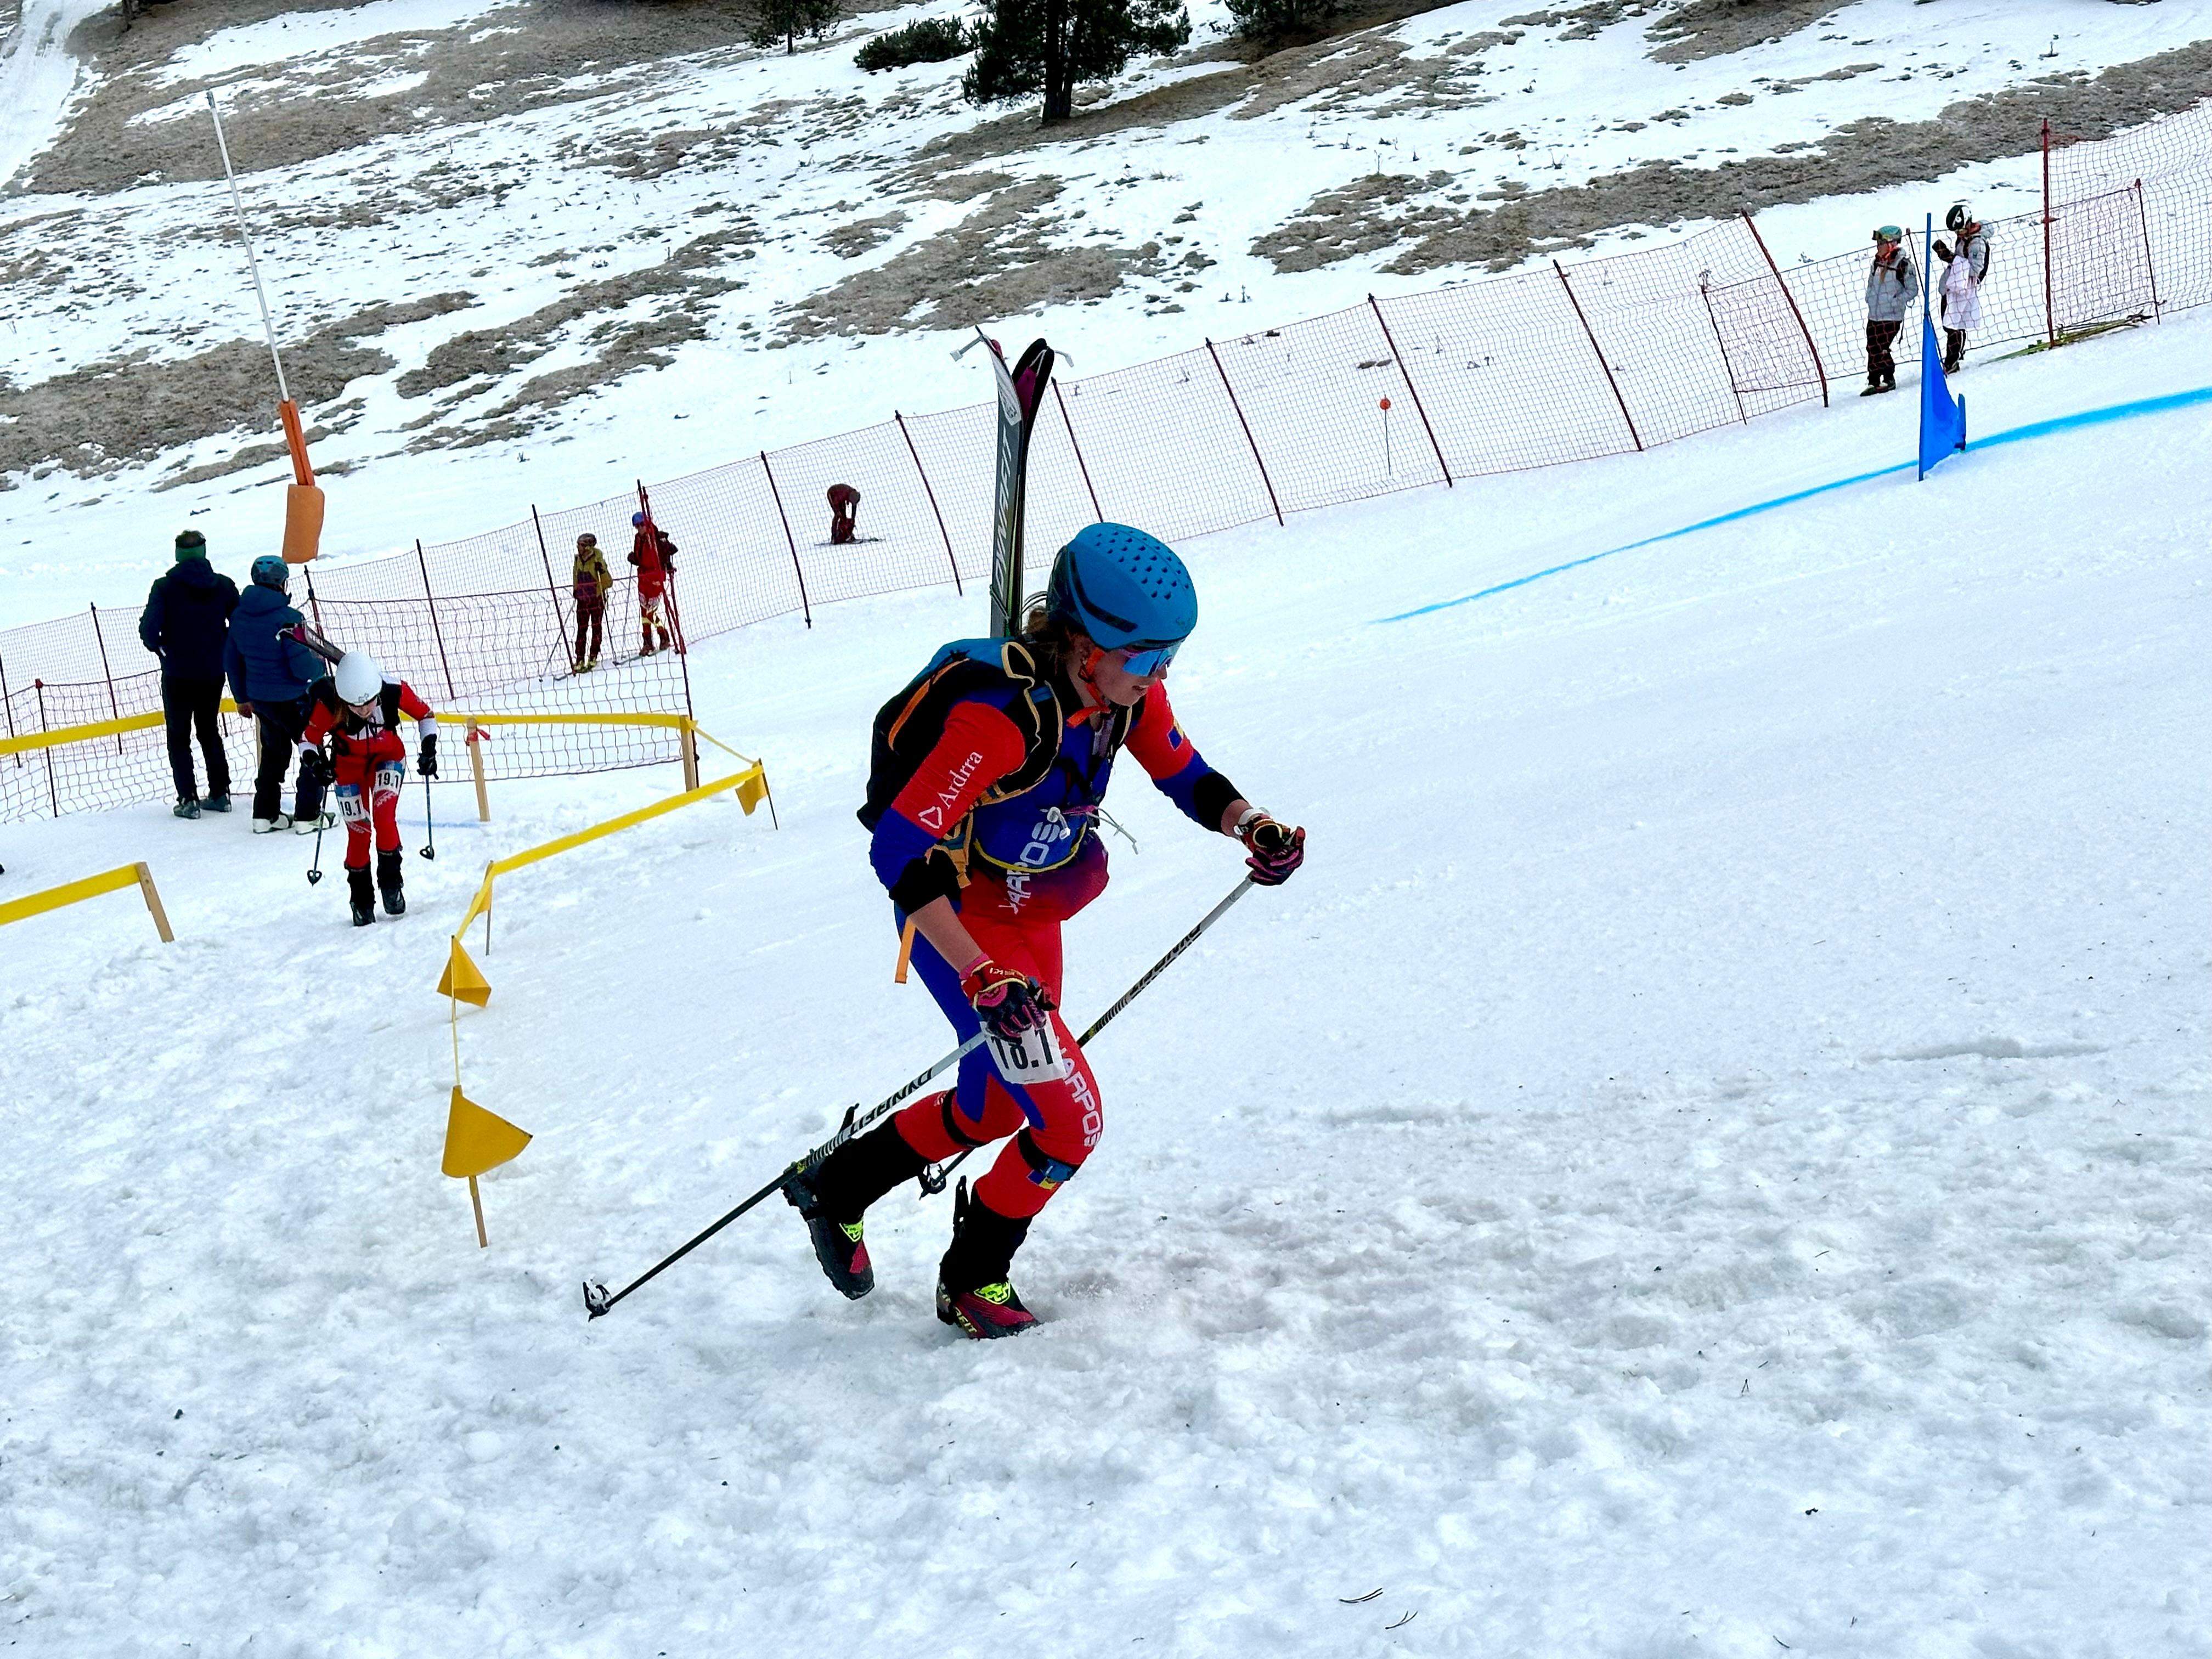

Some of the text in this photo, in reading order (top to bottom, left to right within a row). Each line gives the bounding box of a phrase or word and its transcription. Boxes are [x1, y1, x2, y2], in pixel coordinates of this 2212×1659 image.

[377, 772, 399, 788] 19.1
[340, 799, 362, 816] 19.1
[1056, 1036, 1102, 1147] ARPOS
